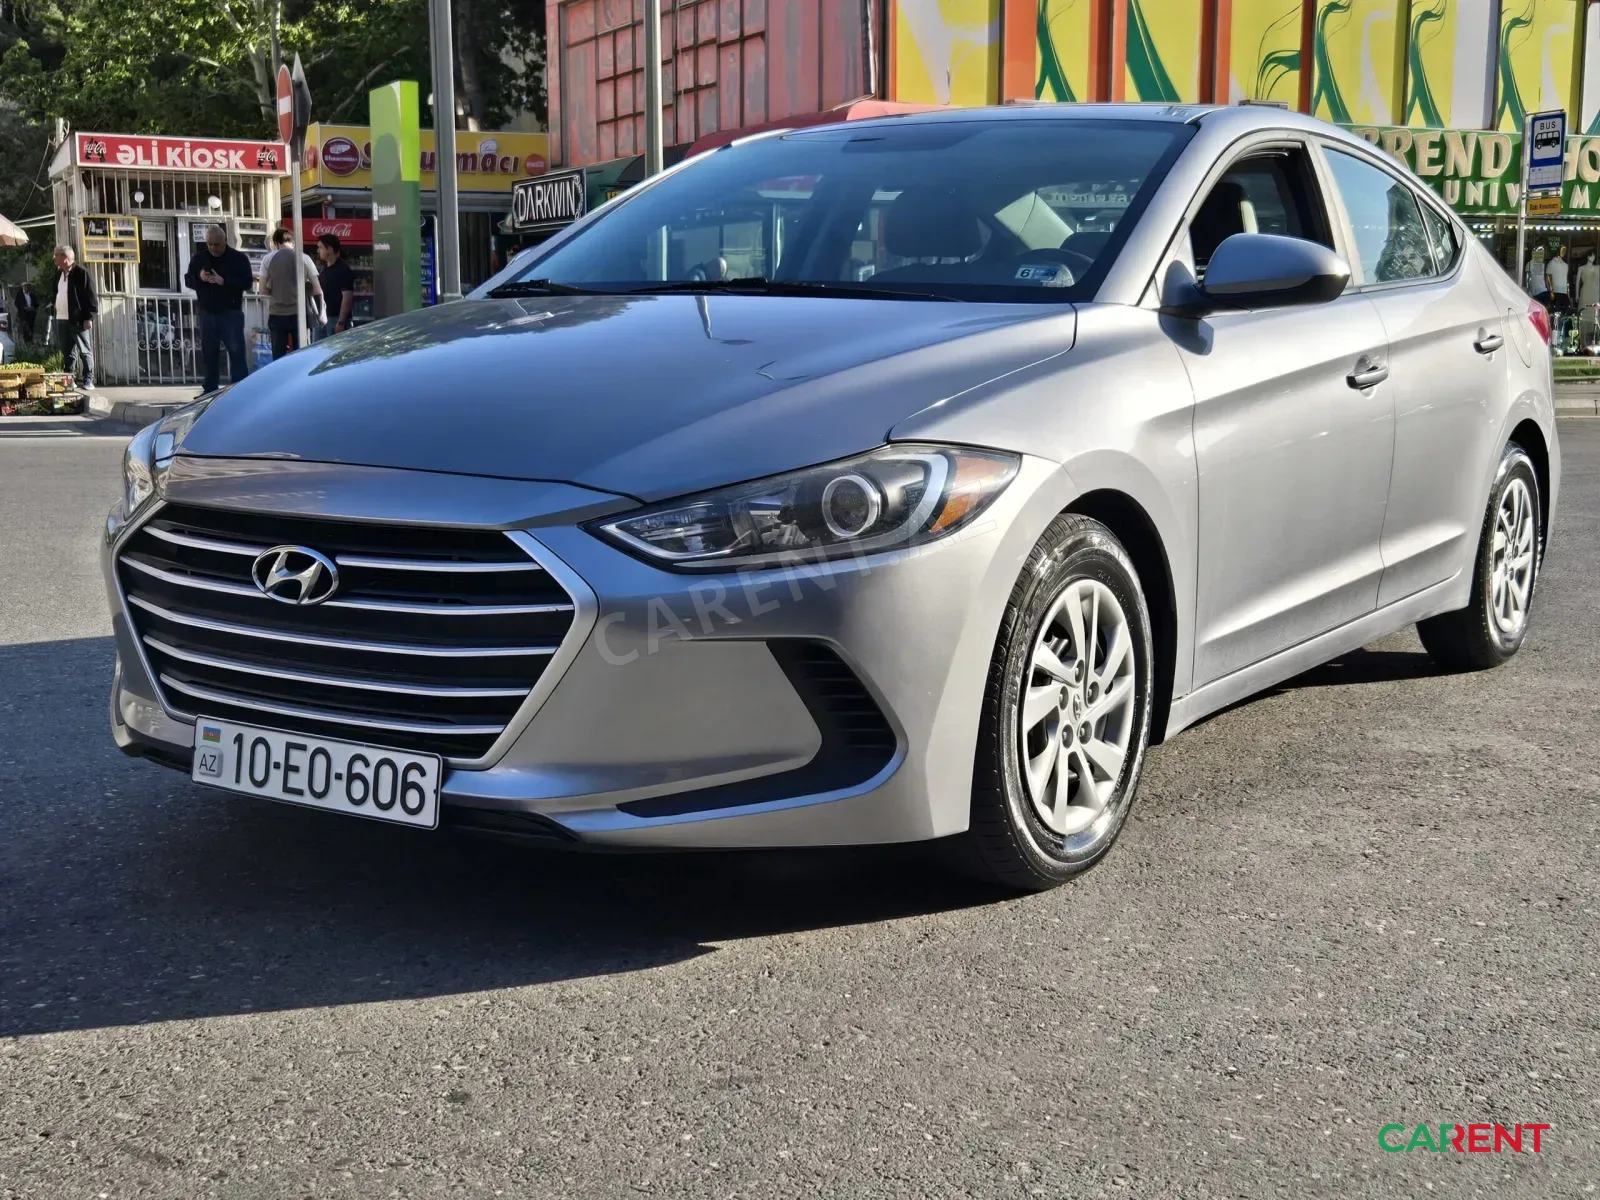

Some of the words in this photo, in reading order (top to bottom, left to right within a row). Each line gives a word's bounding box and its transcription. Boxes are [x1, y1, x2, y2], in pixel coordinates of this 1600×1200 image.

[1540, 121, 1556, 130] BUS
[116, 140, 159, 166] ƏLİ
[166, 142, 246, 170] KİOSK
[518, 179, 576, 222] DARKWIN
[1020, 268, 1031, 278] 6
[199, 754, 217, 772] AZ
